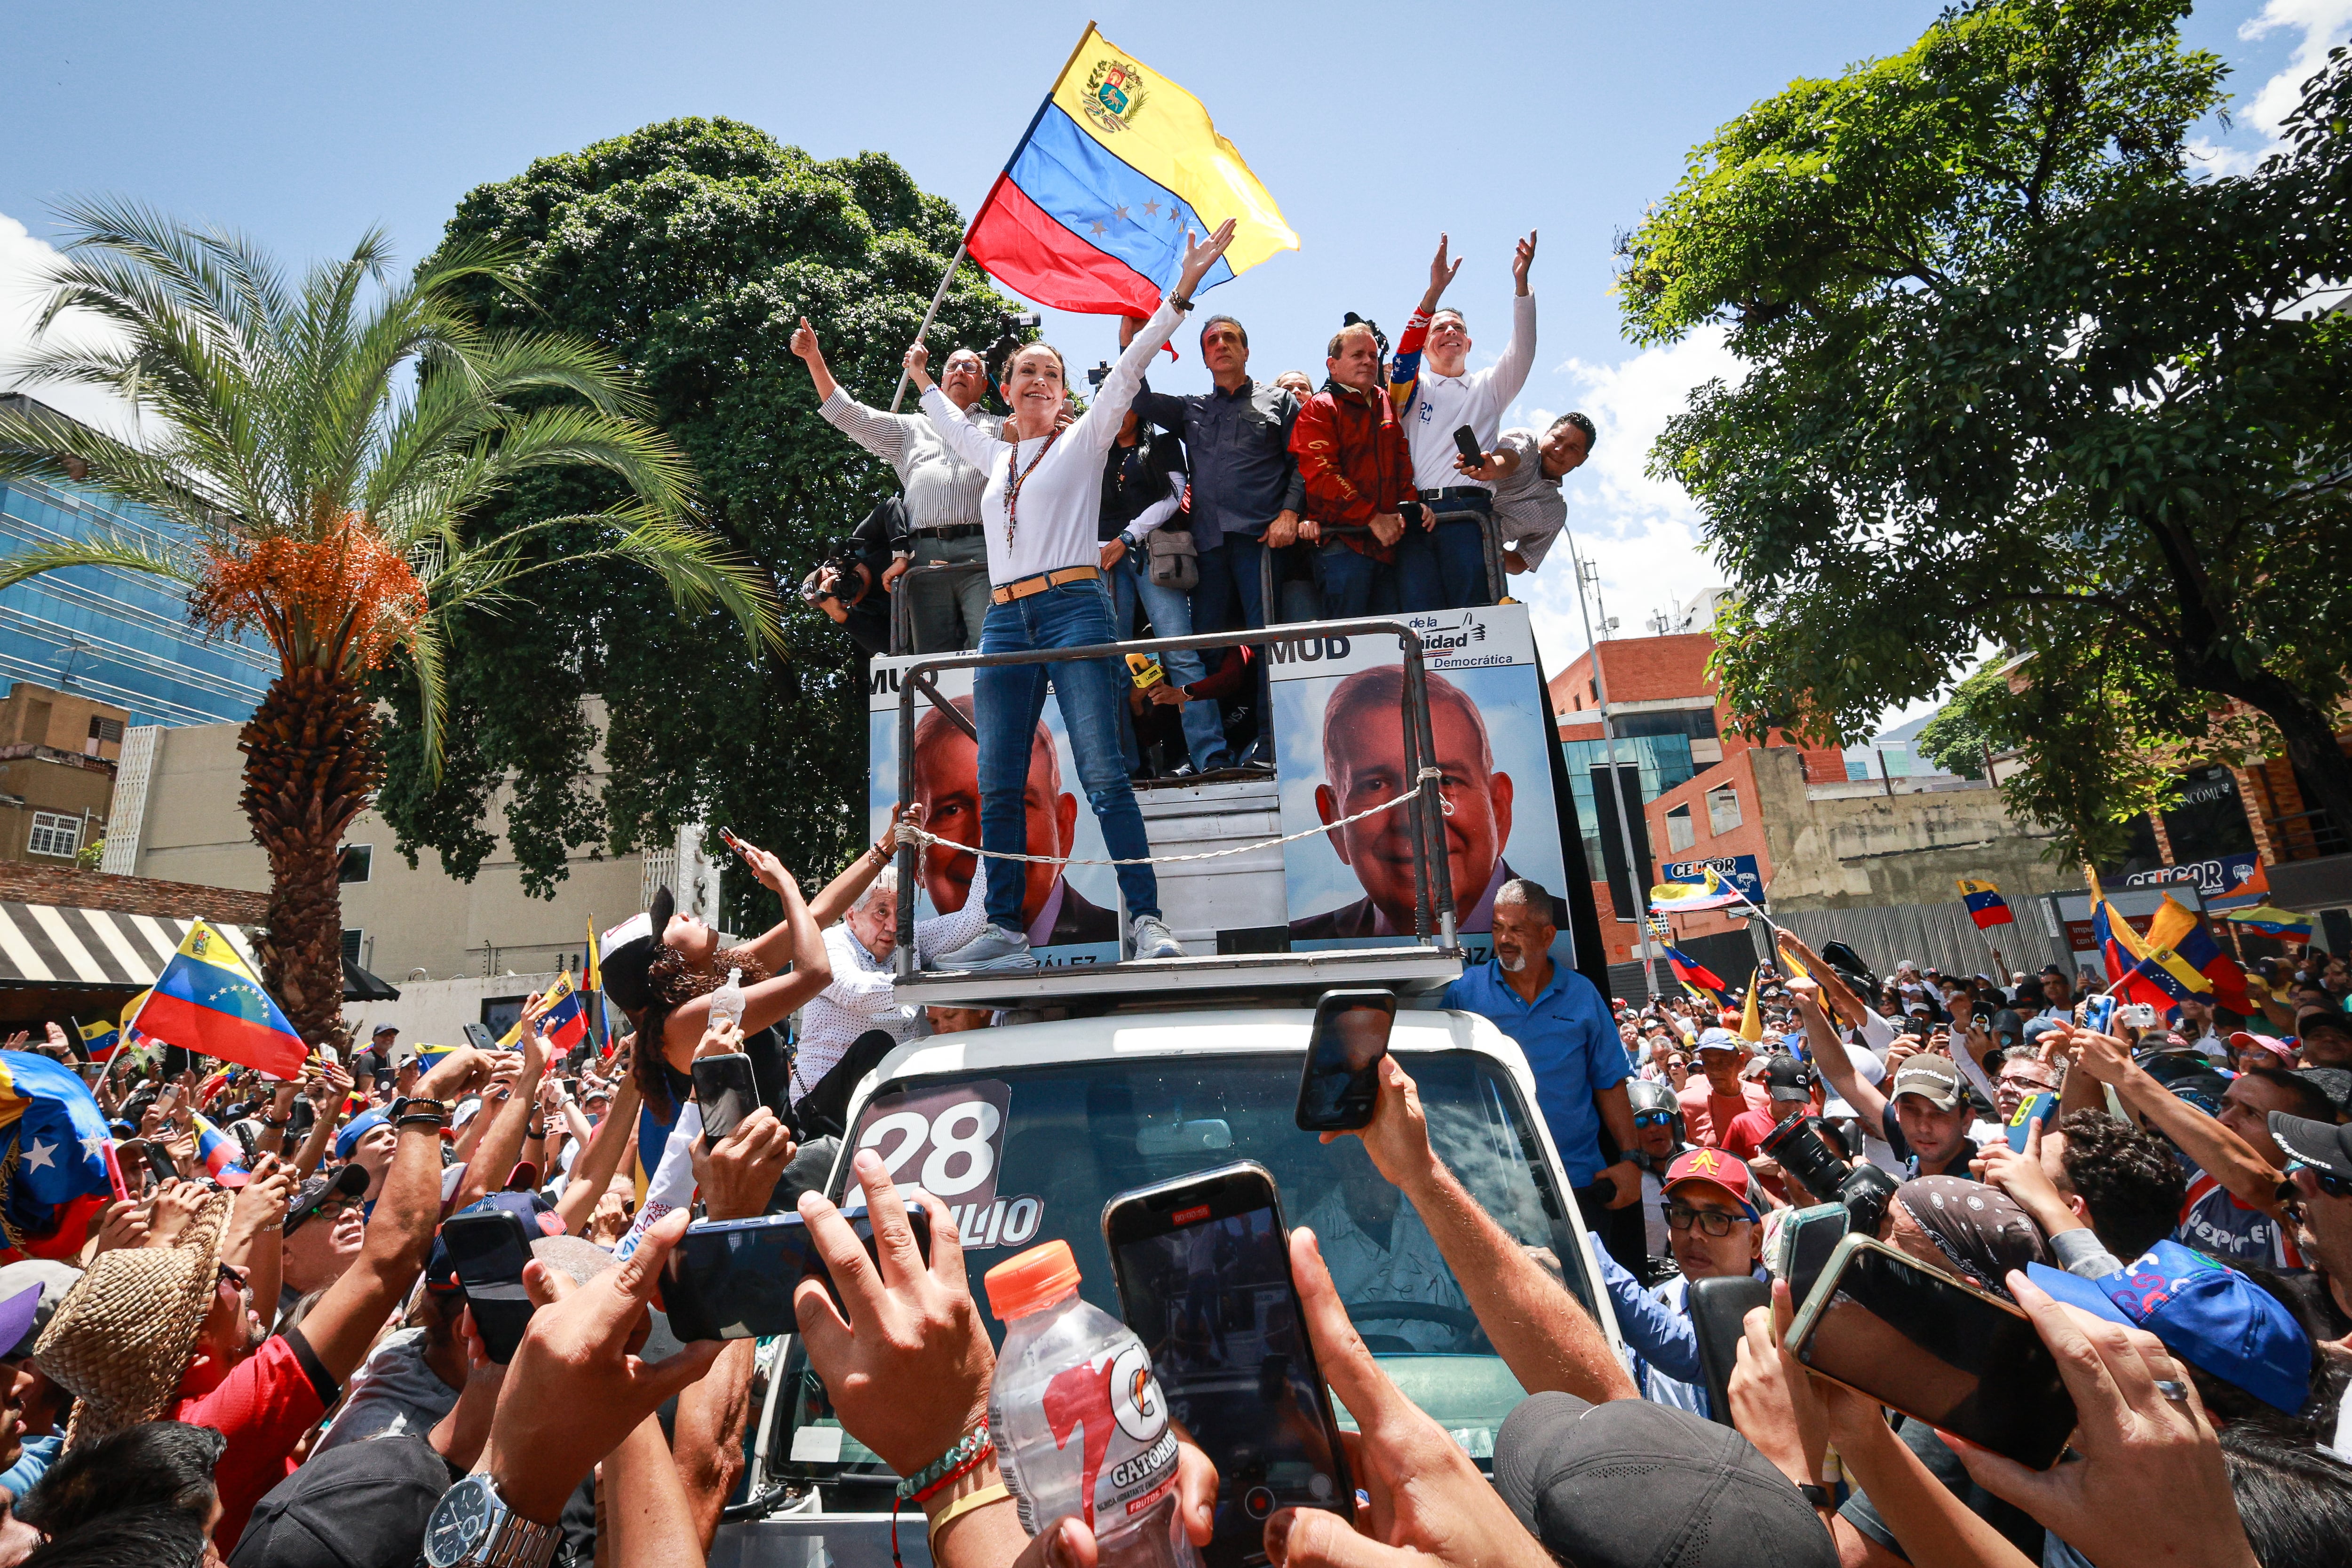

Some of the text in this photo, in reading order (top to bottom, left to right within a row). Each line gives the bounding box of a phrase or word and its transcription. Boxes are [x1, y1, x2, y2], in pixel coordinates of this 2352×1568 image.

[1409, 616, 1438, 629] de la
[1269, 636, 1351, 665] MUD
[1434, 655, 1513, 669] Democrática
[845, 1101, 1001, 1208] 28
[1129, 1492, 1160, 1512] FRUTOS
